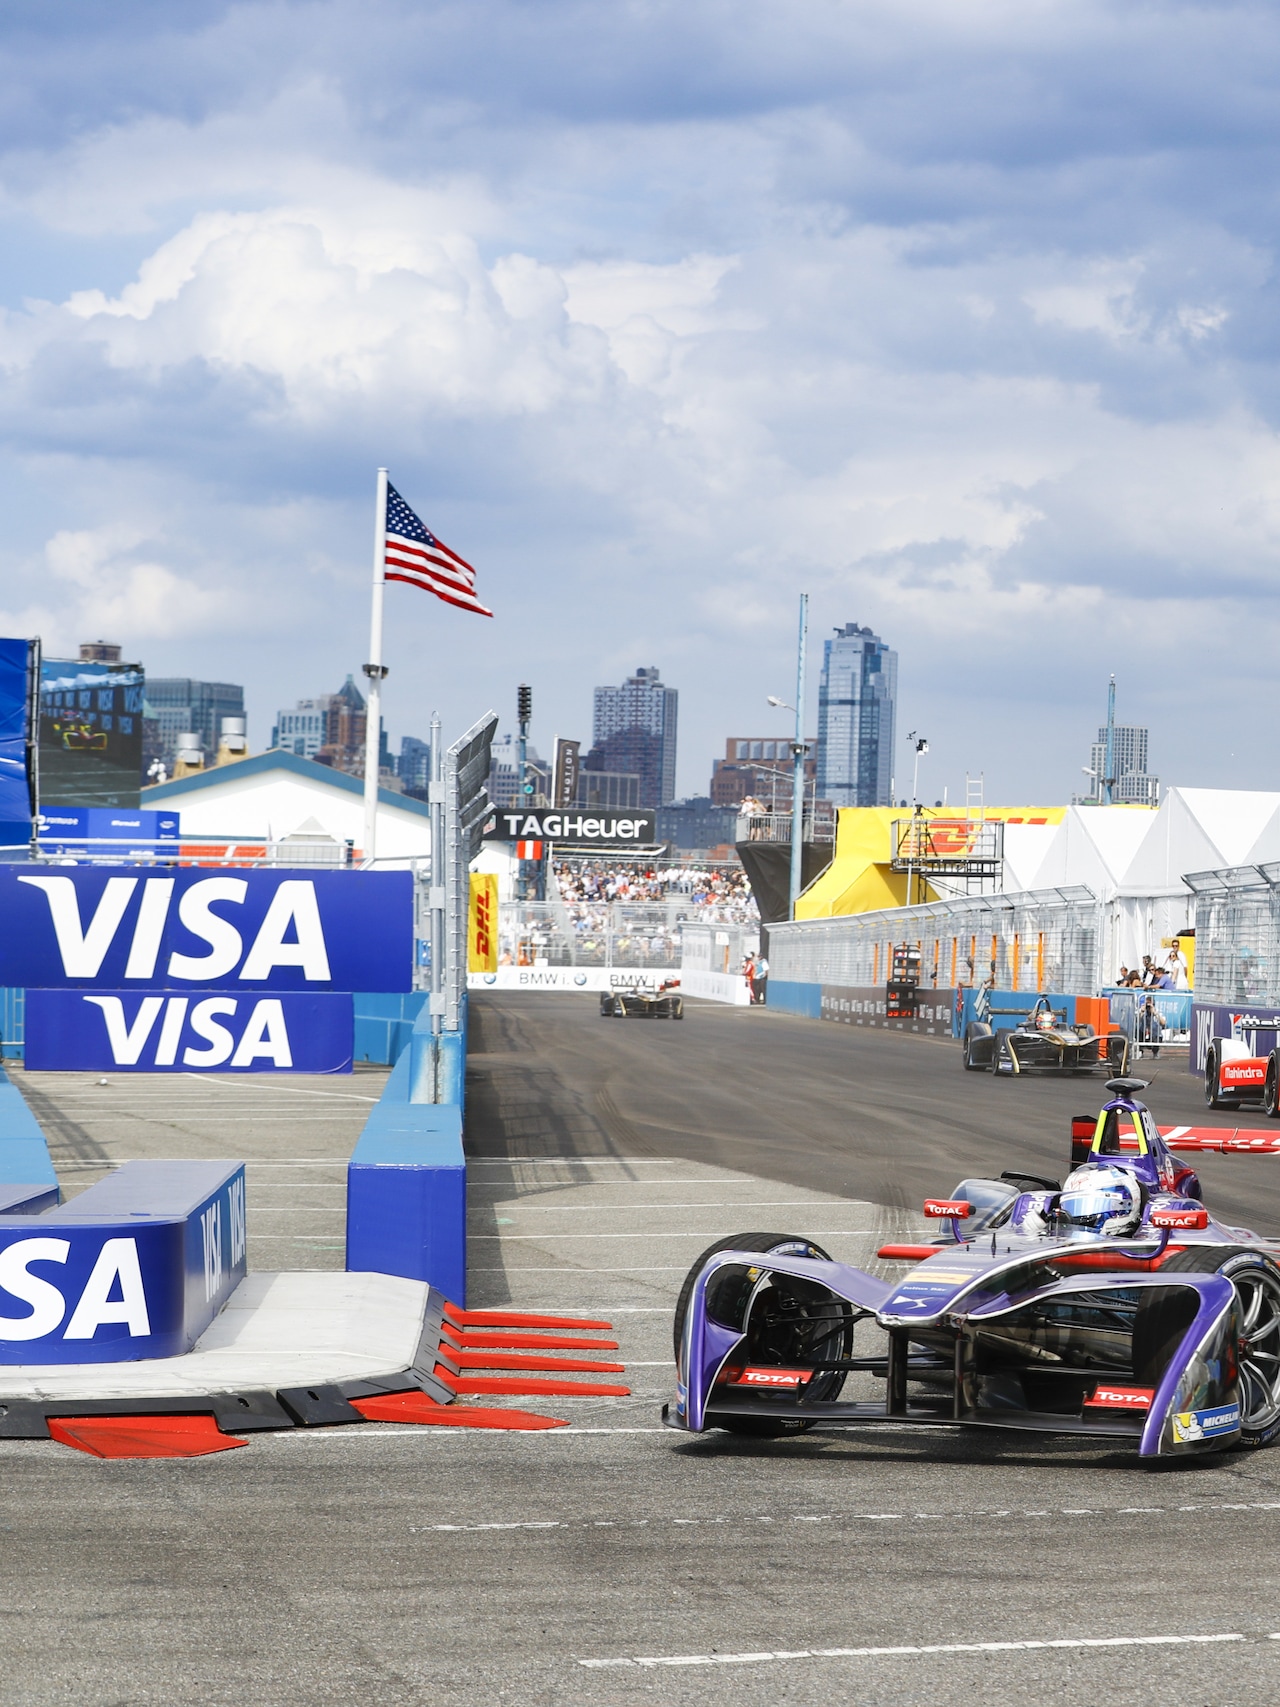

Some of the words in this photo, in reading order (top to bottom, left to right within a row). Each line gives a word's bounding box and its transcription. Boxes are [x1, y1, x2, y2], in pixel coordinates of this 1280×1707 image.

[17, 875, 332, 981] VISA
[476, 891, 491, 957] DHL
[519, 972, 558, 985] BMW
[83, 995, 294, 1067] VISA
[1225, 1066, 1264, 1079] Mahindra
[928, 1204, 963, 1216] TOTAL
[200, 1199, 223, 1304] VISA
[1097, 1391, 1150, 1403] TOTA
[1202, 1410, 1240, 1428] MICHELIN
